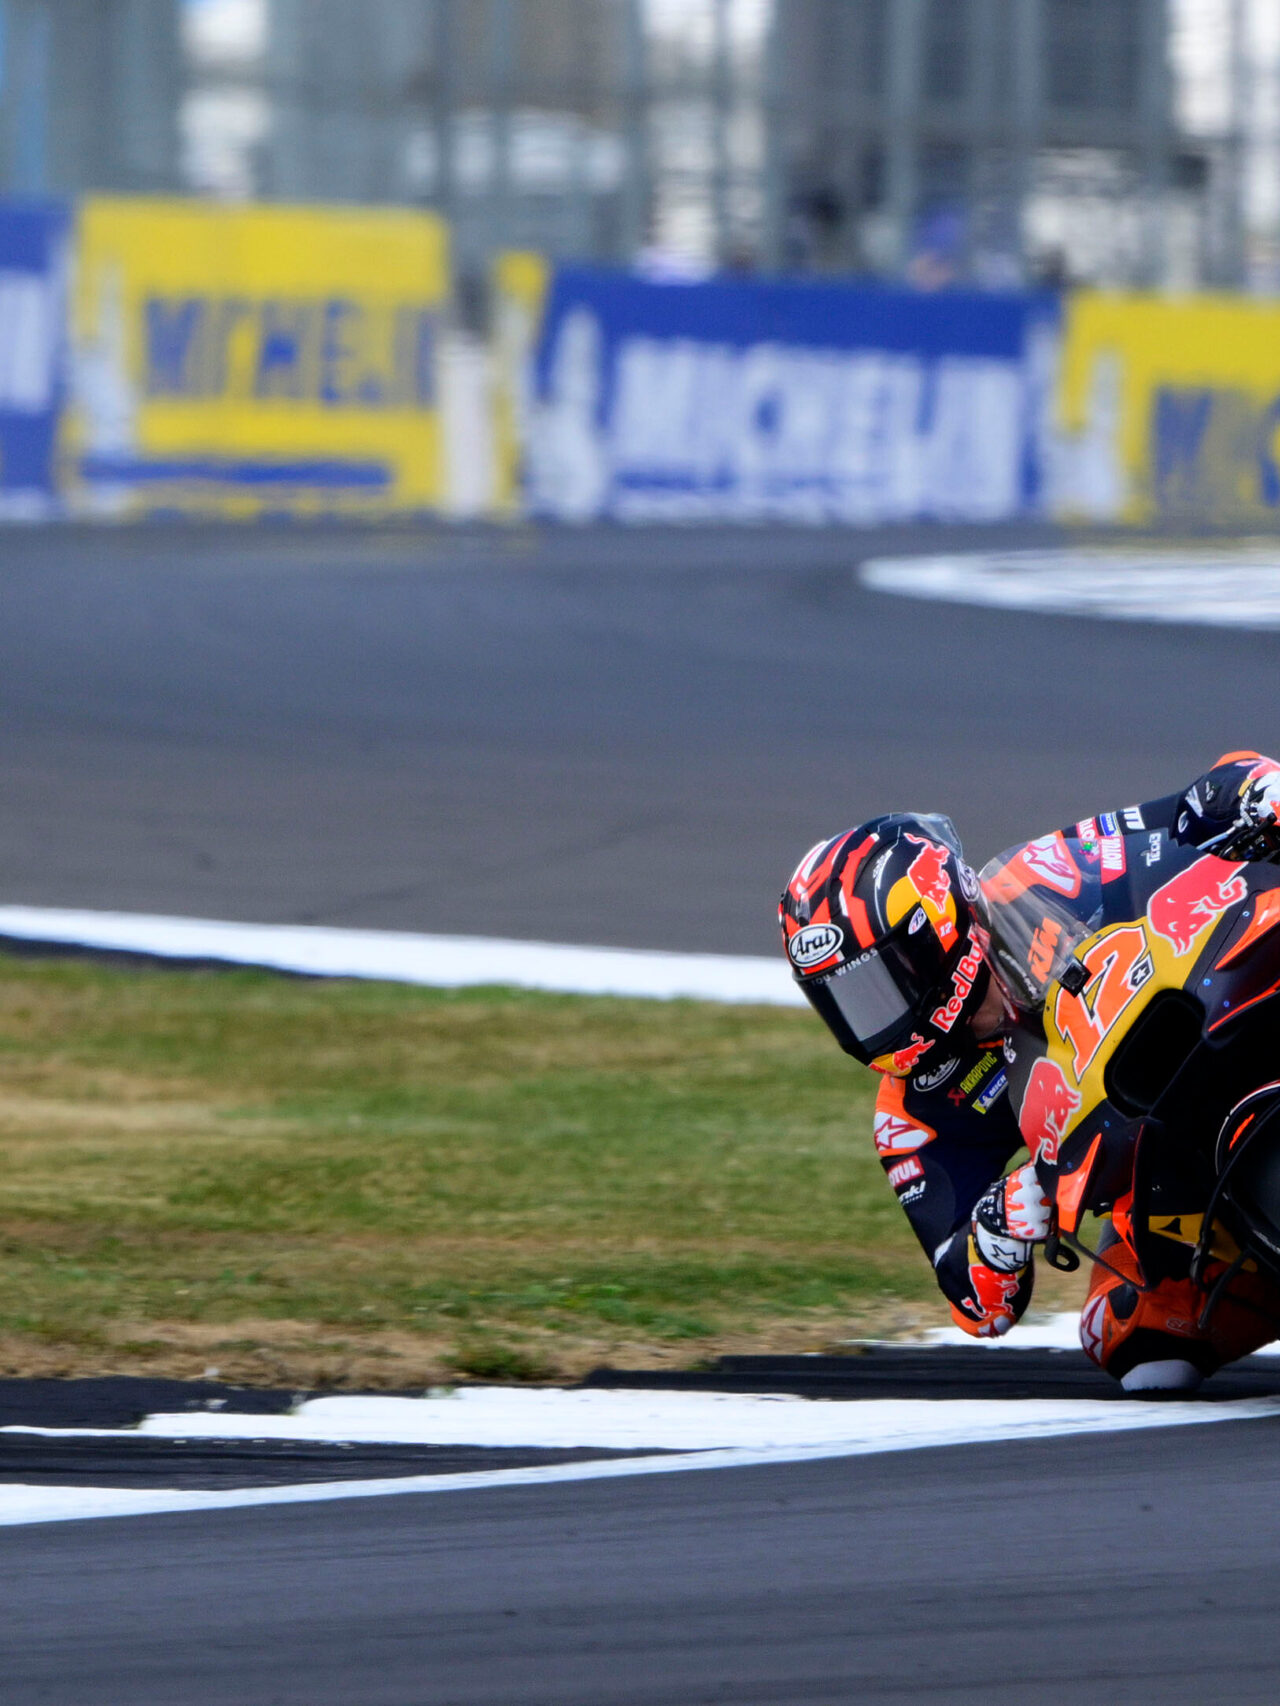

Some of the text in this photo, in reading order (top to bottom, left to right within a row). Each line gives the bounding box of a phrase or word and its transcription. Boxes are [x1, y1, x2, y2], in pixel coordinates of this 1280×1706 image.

[1101, 837, 1123, 871] MOTUL
[793, 928, 832, 959] Arai
[1027, 917, 1062, 984] KTM
[834, 947, 878, 977] WINGS
[1055, 924, 1150, 1081] 12
